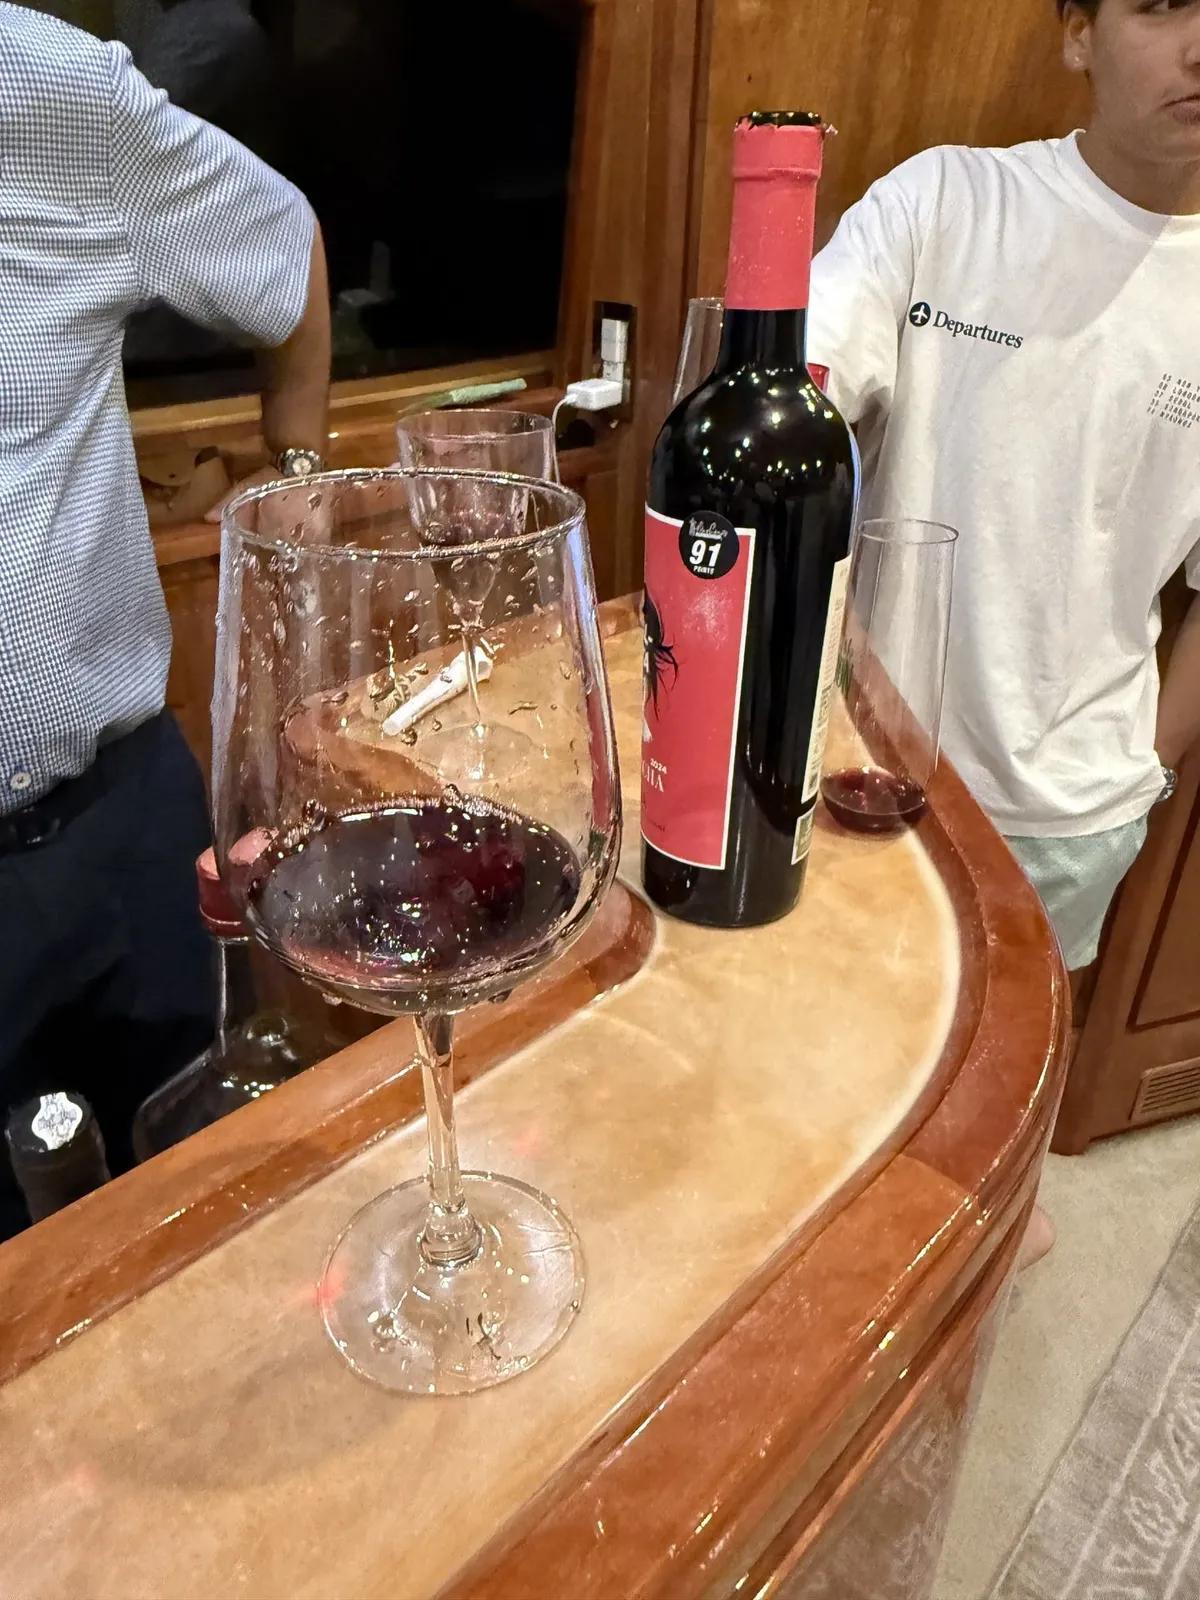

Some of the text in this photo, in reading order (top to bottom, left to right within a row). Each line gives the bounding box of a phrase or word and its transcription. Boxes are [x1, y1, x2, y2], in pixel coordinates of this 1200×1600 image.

[933, 310, 1024, 348] Departures
[689, 539, 722, 567] 91
[650, 758, 667, 774] 2024
